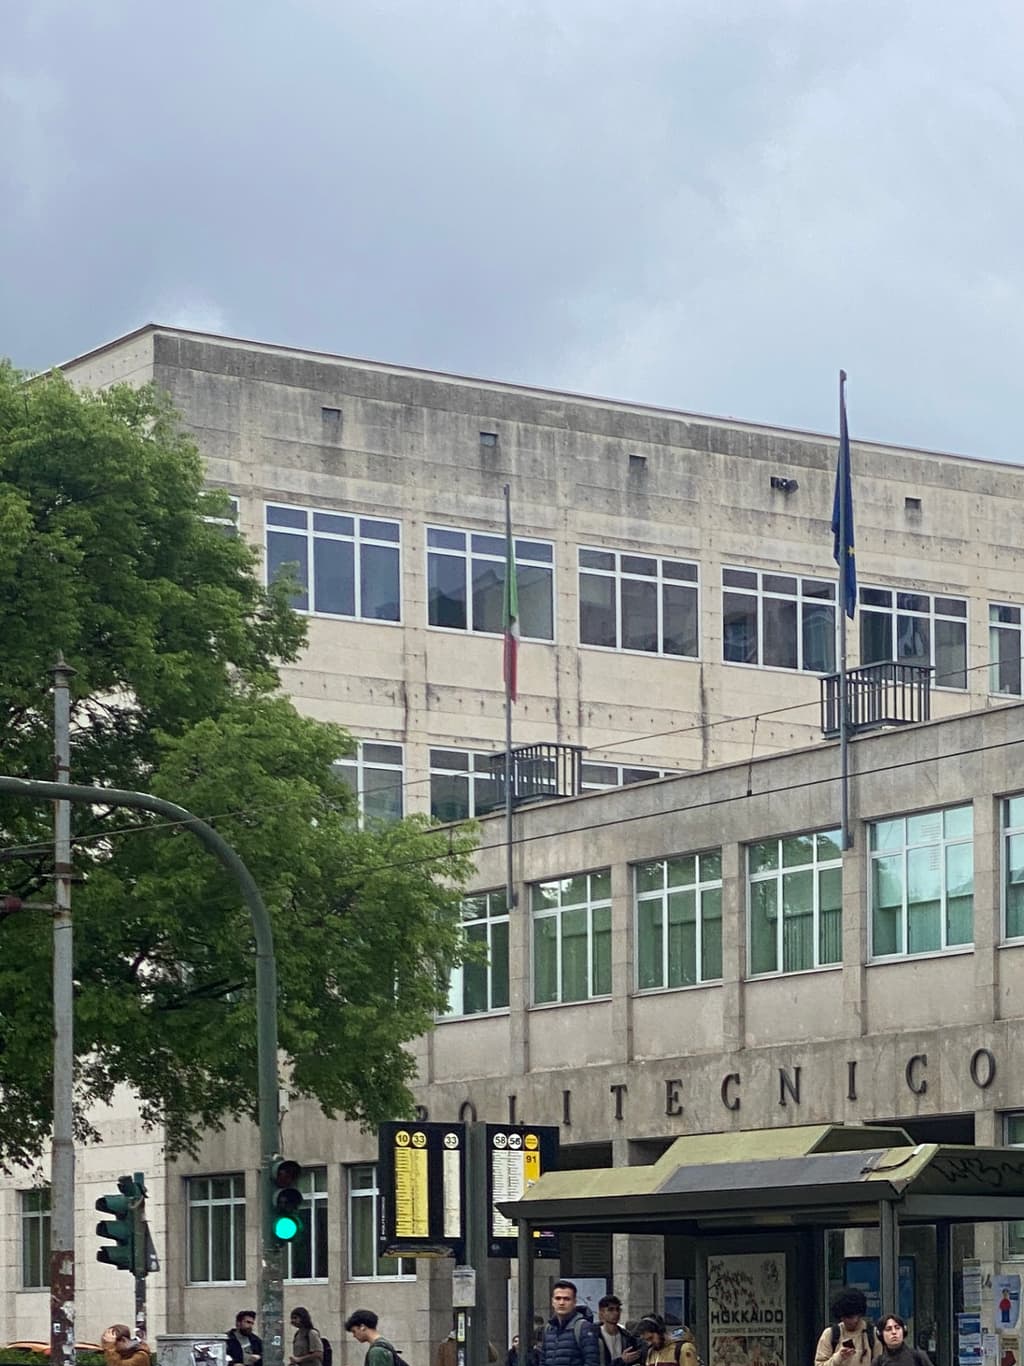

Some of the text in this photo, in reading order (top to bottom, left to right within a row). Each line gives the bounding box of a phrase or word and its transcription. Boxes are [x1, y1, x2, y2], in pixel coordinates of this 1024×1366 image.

[397, 1135, 408, 1143] 10
[414, 1135, 425, 1143] 33
[446, 1136, 457, 1144] 33
[495, 1136, 506, 1144] 58
[526, 1155, 537, 1163] 91
[711, 1309, 784, 1324] HOKKAIDO
